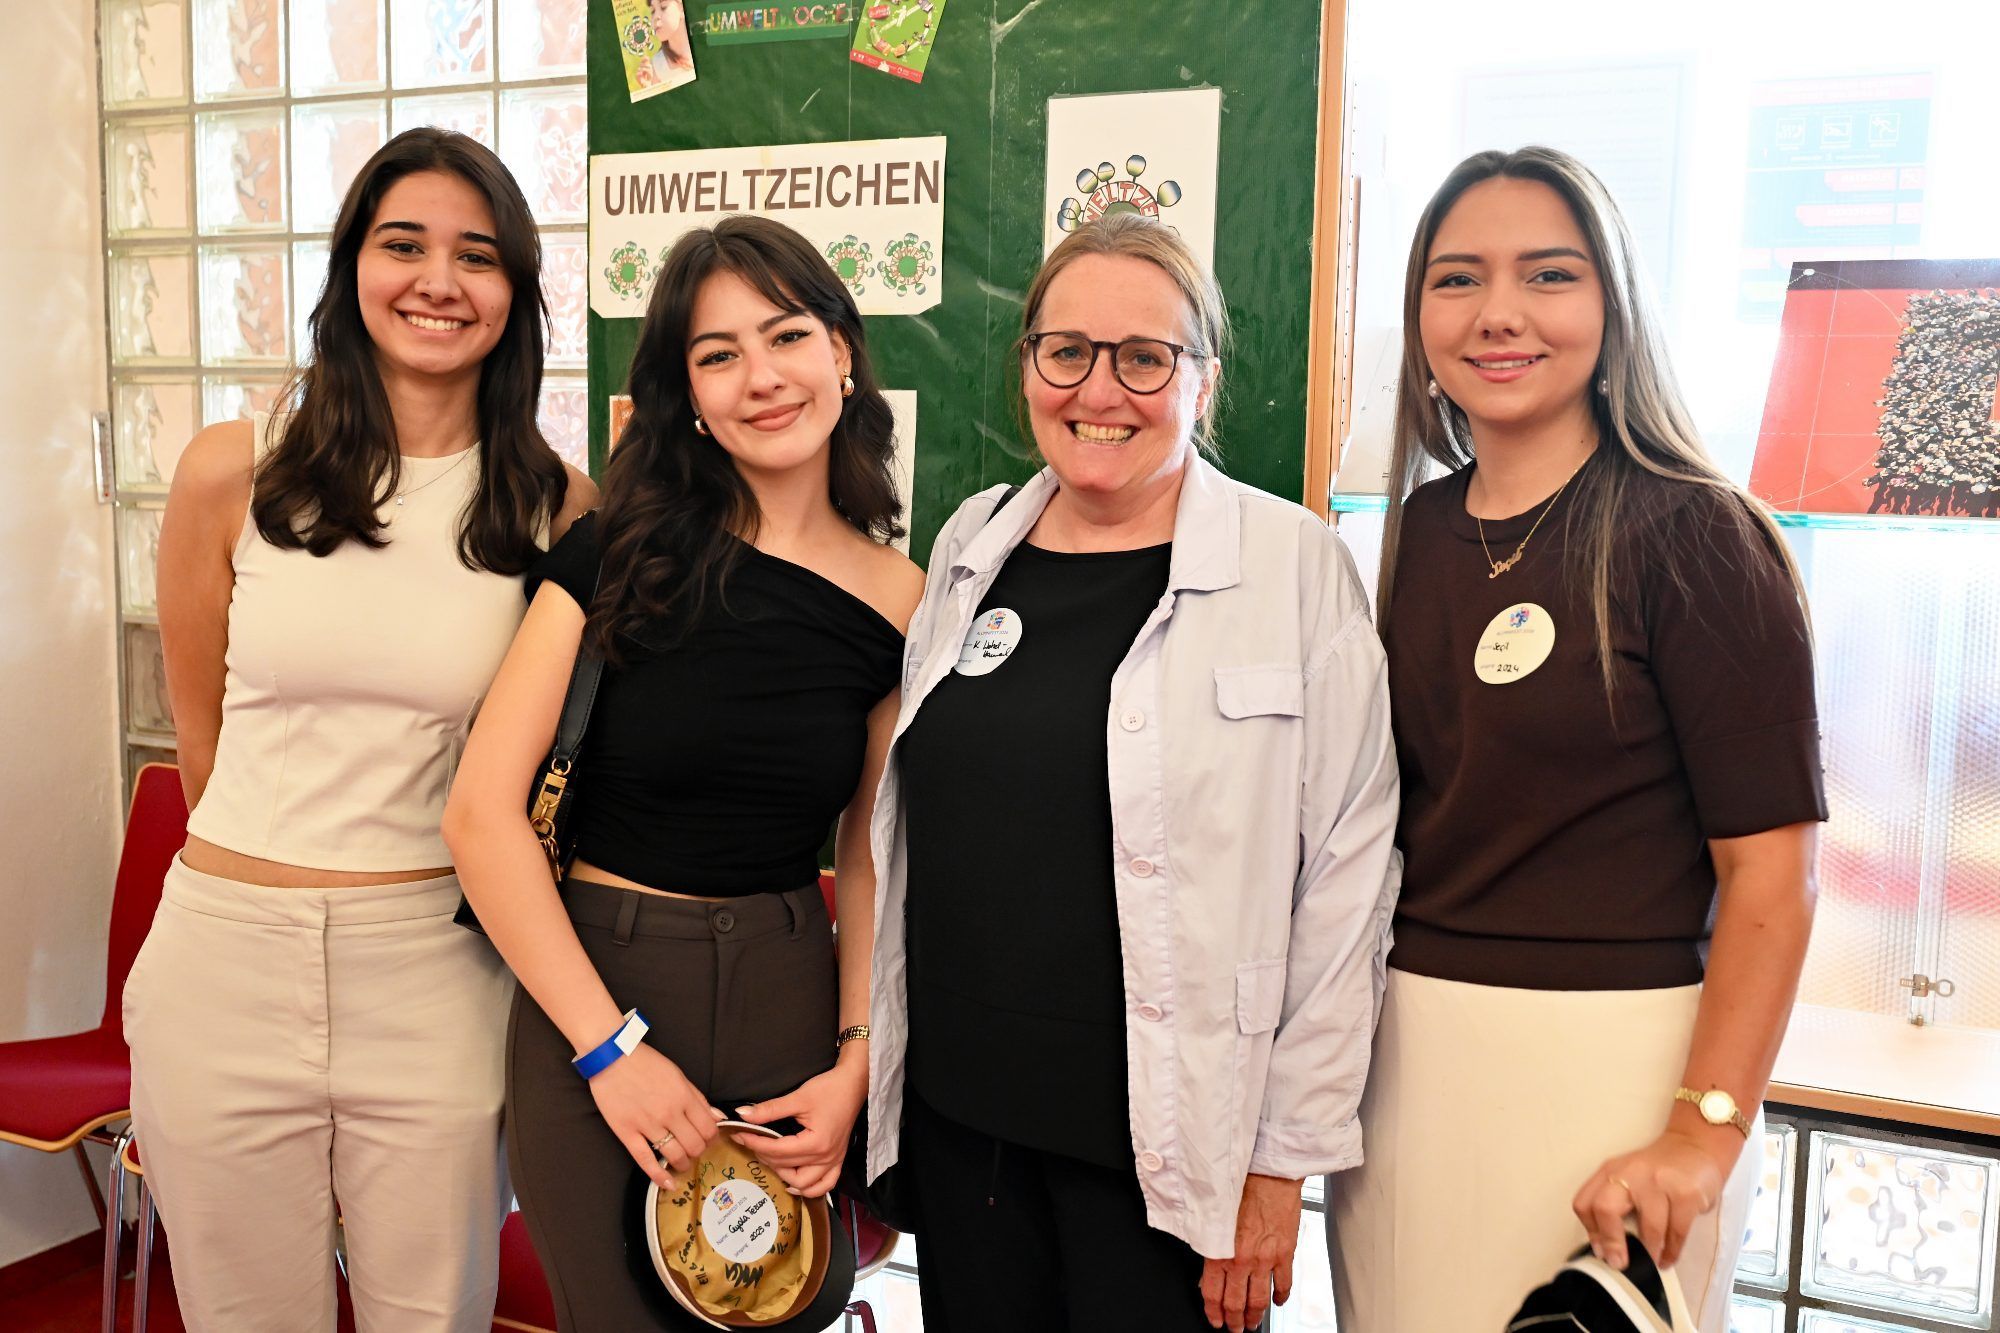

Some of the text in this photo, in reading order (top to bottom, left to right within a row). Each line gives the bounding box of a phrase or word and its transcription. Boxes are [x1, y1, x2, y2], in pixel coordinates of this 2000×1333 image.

[709, 8, 780, 33] UMWELT
[604, 160, 940, 216] UMWELTZEICHEN
[1496, 664, 1519, 672] 2024
